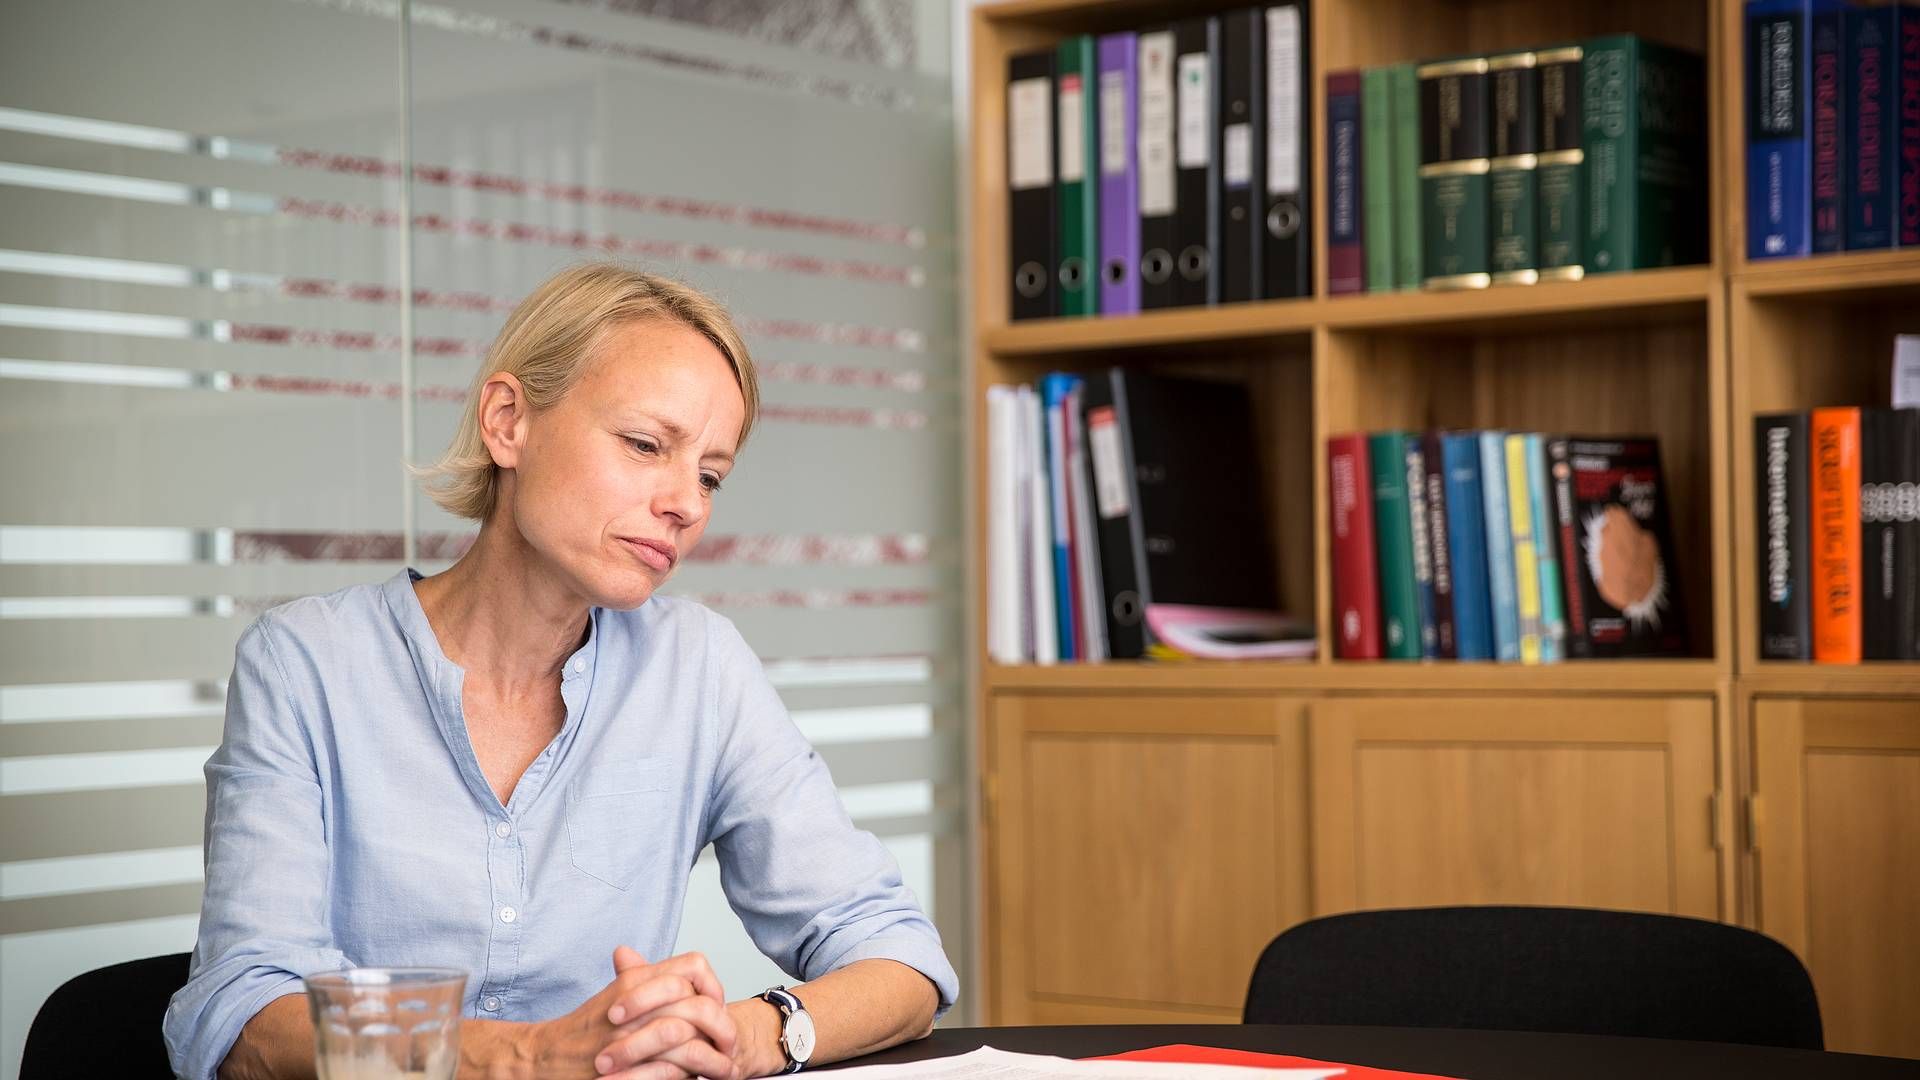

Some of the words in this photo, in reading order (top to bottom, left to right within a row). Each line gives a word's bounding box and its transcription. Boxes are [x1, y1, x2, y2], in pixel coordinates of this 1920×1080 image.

[1584, 50, 1603, 129] SAGER
[1603, 48, 1626, 139] FOGED
[1768, 427, 1790, 602] Internetretten
[1823, 556, 1852, 618] JURA
